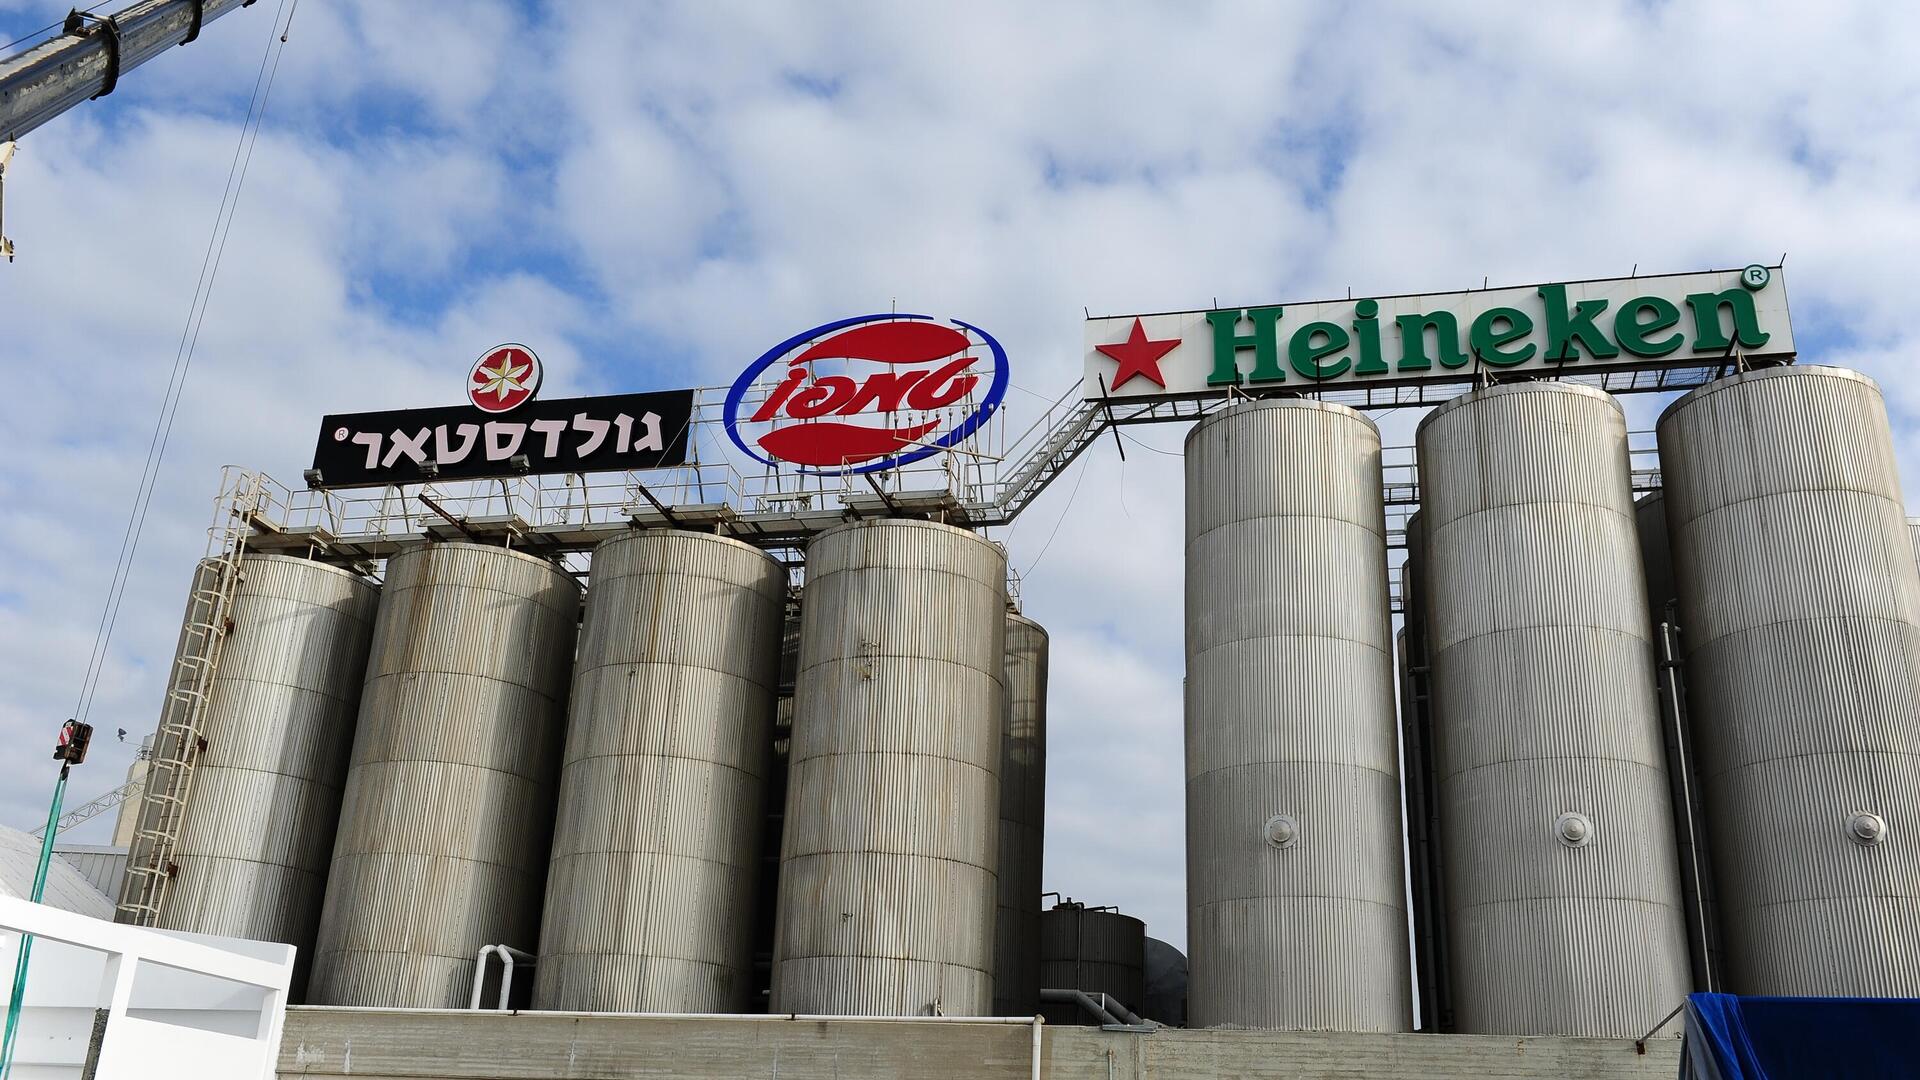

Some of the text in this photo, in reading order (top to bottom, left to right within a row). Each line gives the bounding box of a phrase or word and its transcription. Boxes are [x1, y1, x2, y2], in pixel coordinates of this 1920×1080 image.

[1206, 285, 1771, 385] Heineken
[750, 357, 979, 422] טמפו
[351, 411, 664, 470] גולדסטאר
